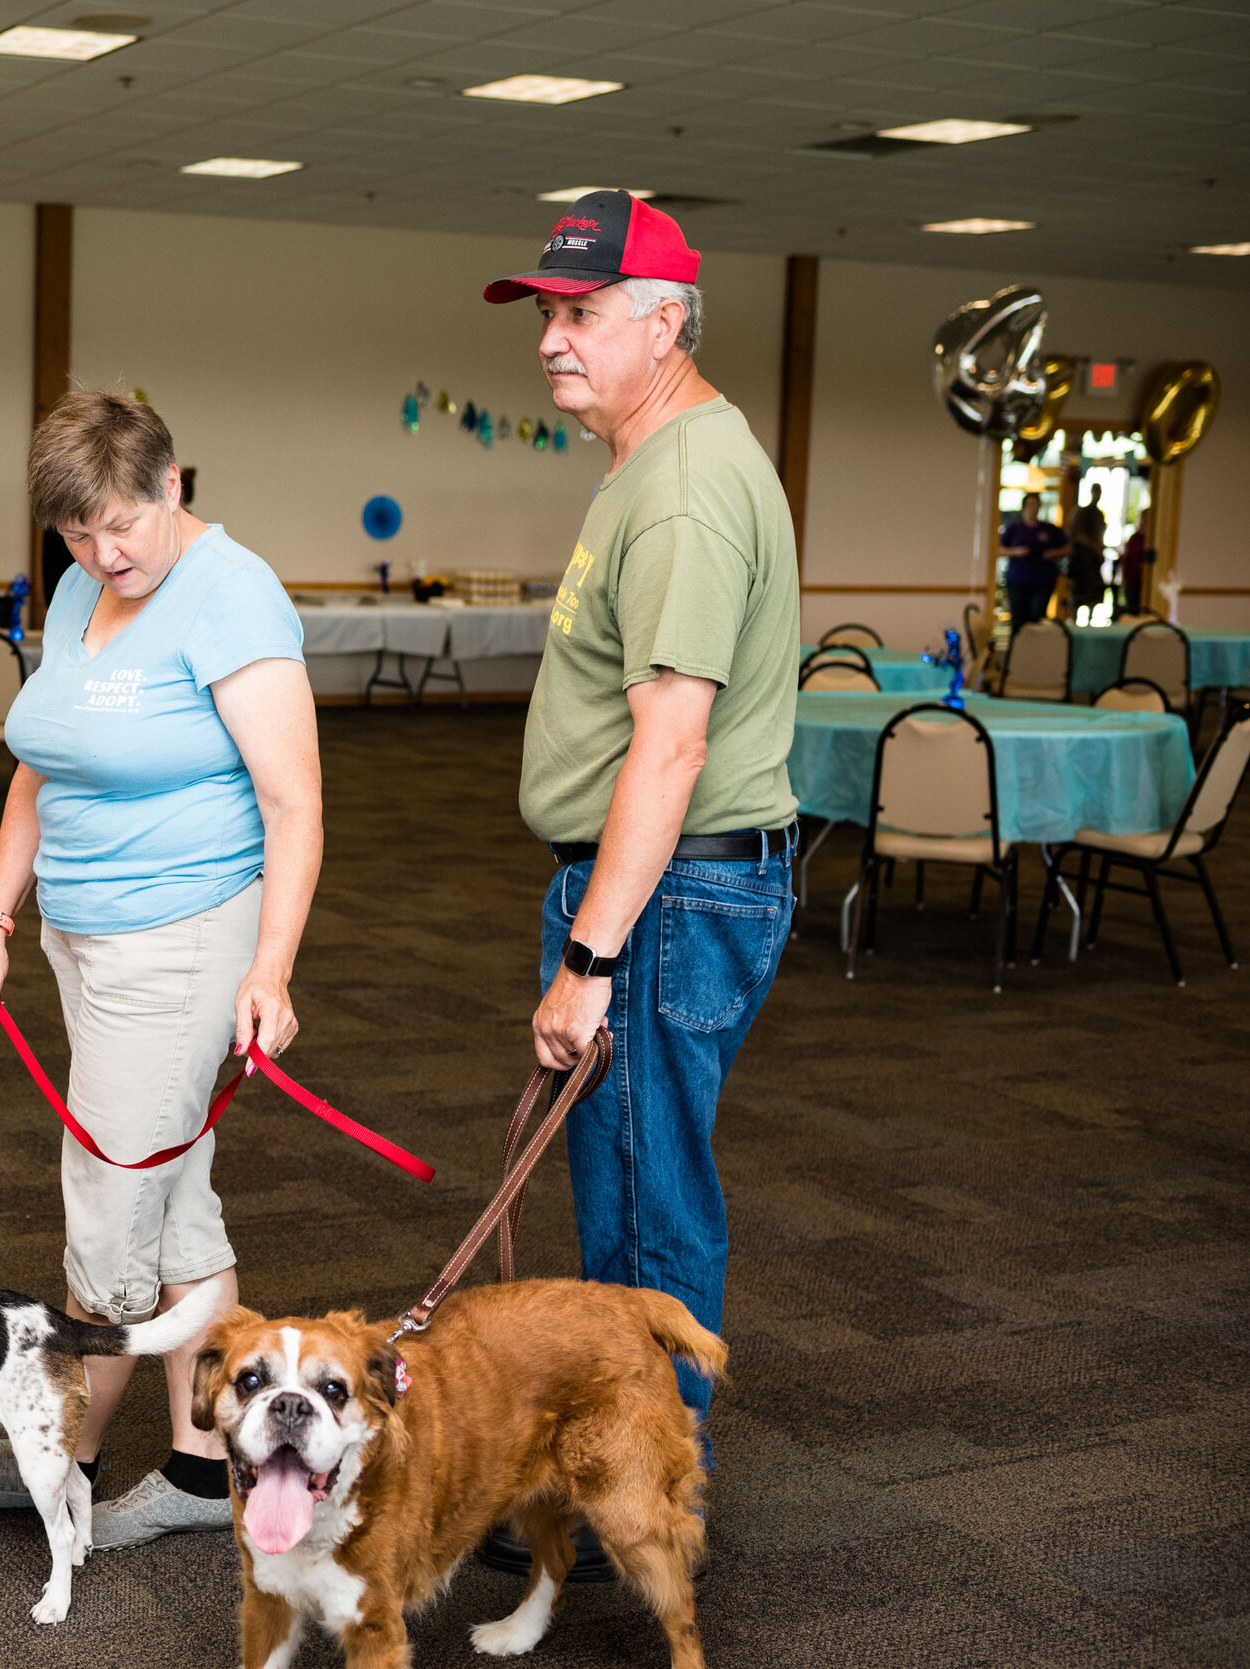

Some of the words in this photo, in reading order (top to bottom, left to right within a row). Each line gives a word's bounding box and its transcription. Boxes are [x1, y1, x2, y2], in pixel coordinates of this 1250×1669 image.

[110, 669, 148, 682] LOVE.
[83, 680, 144, 694] RESPECT.
[86, 694, 141, 707] ADOPT.
